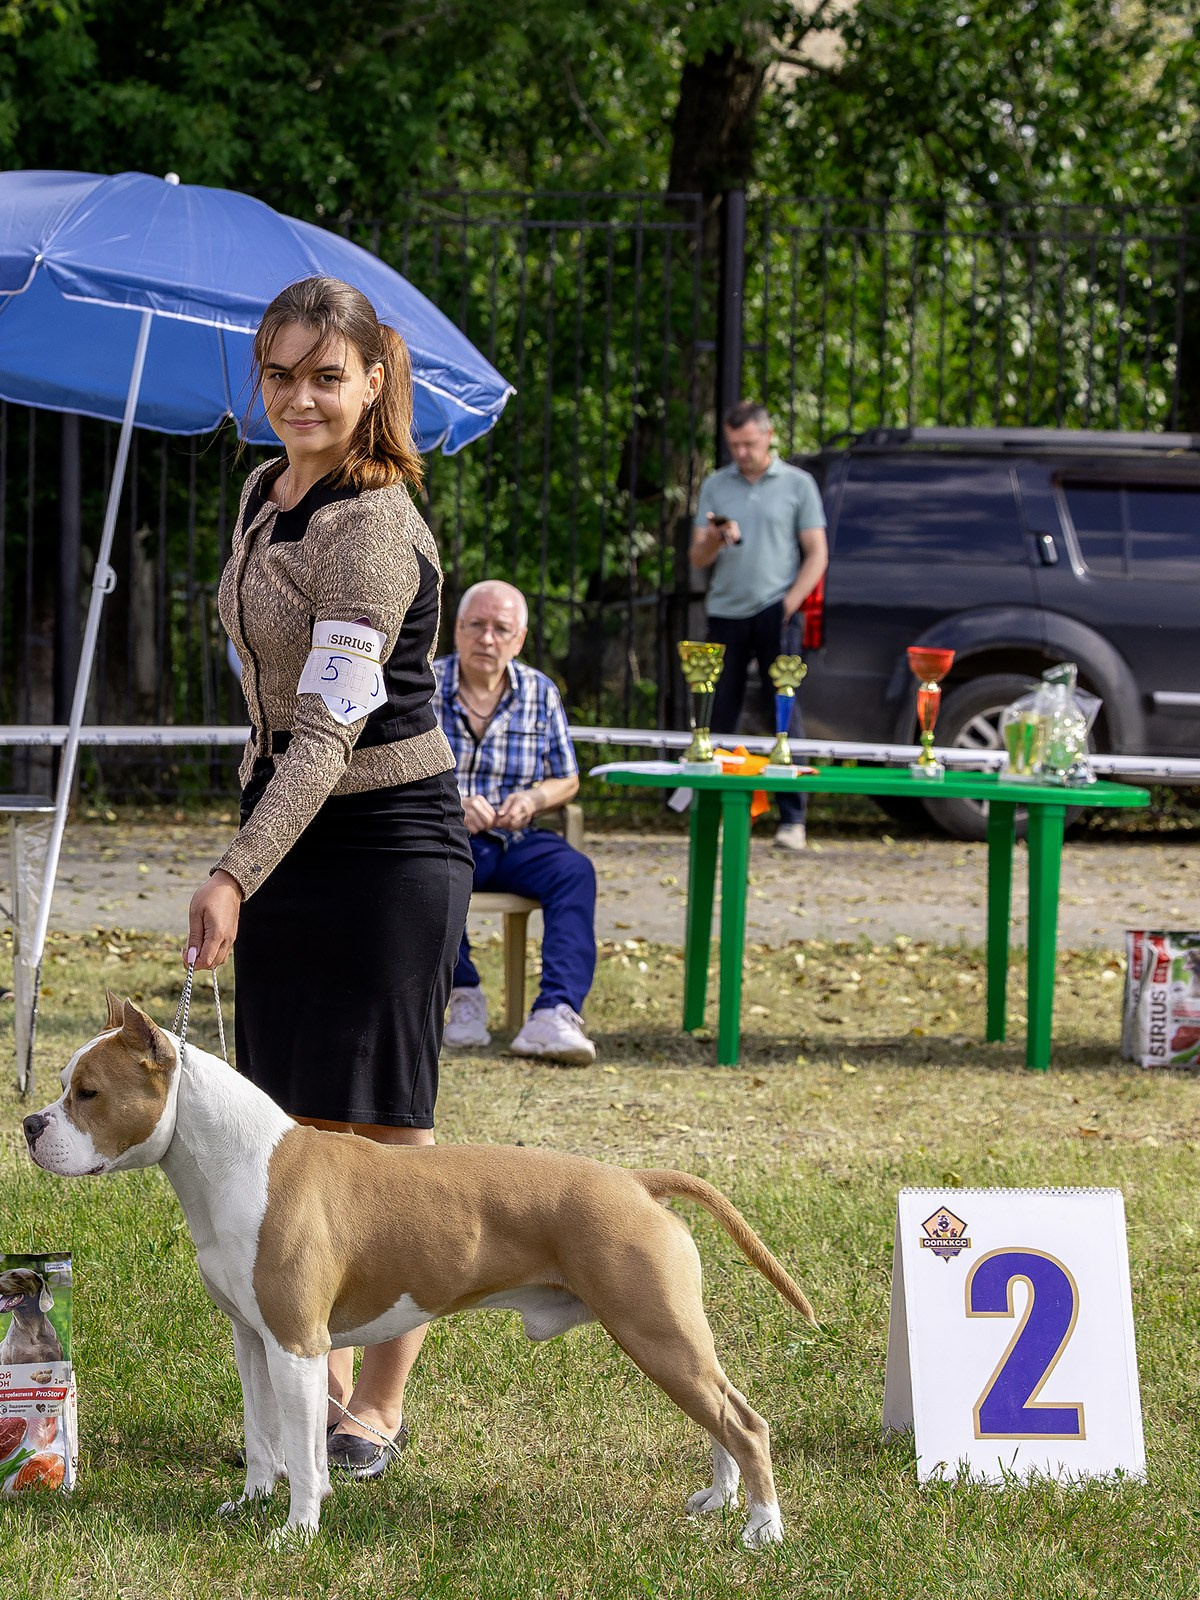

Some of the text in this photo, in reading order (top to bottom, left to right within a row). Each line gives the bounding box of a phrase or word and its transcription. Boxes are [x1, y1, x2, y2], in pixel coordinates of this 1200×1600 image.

[330, 634, 373, 653] SIRIUS
[321, 656, 353, 681] 5
[1149, 990, 1168, 1057] SIRIUS
[965, 1246, 1087, 1441] 2
